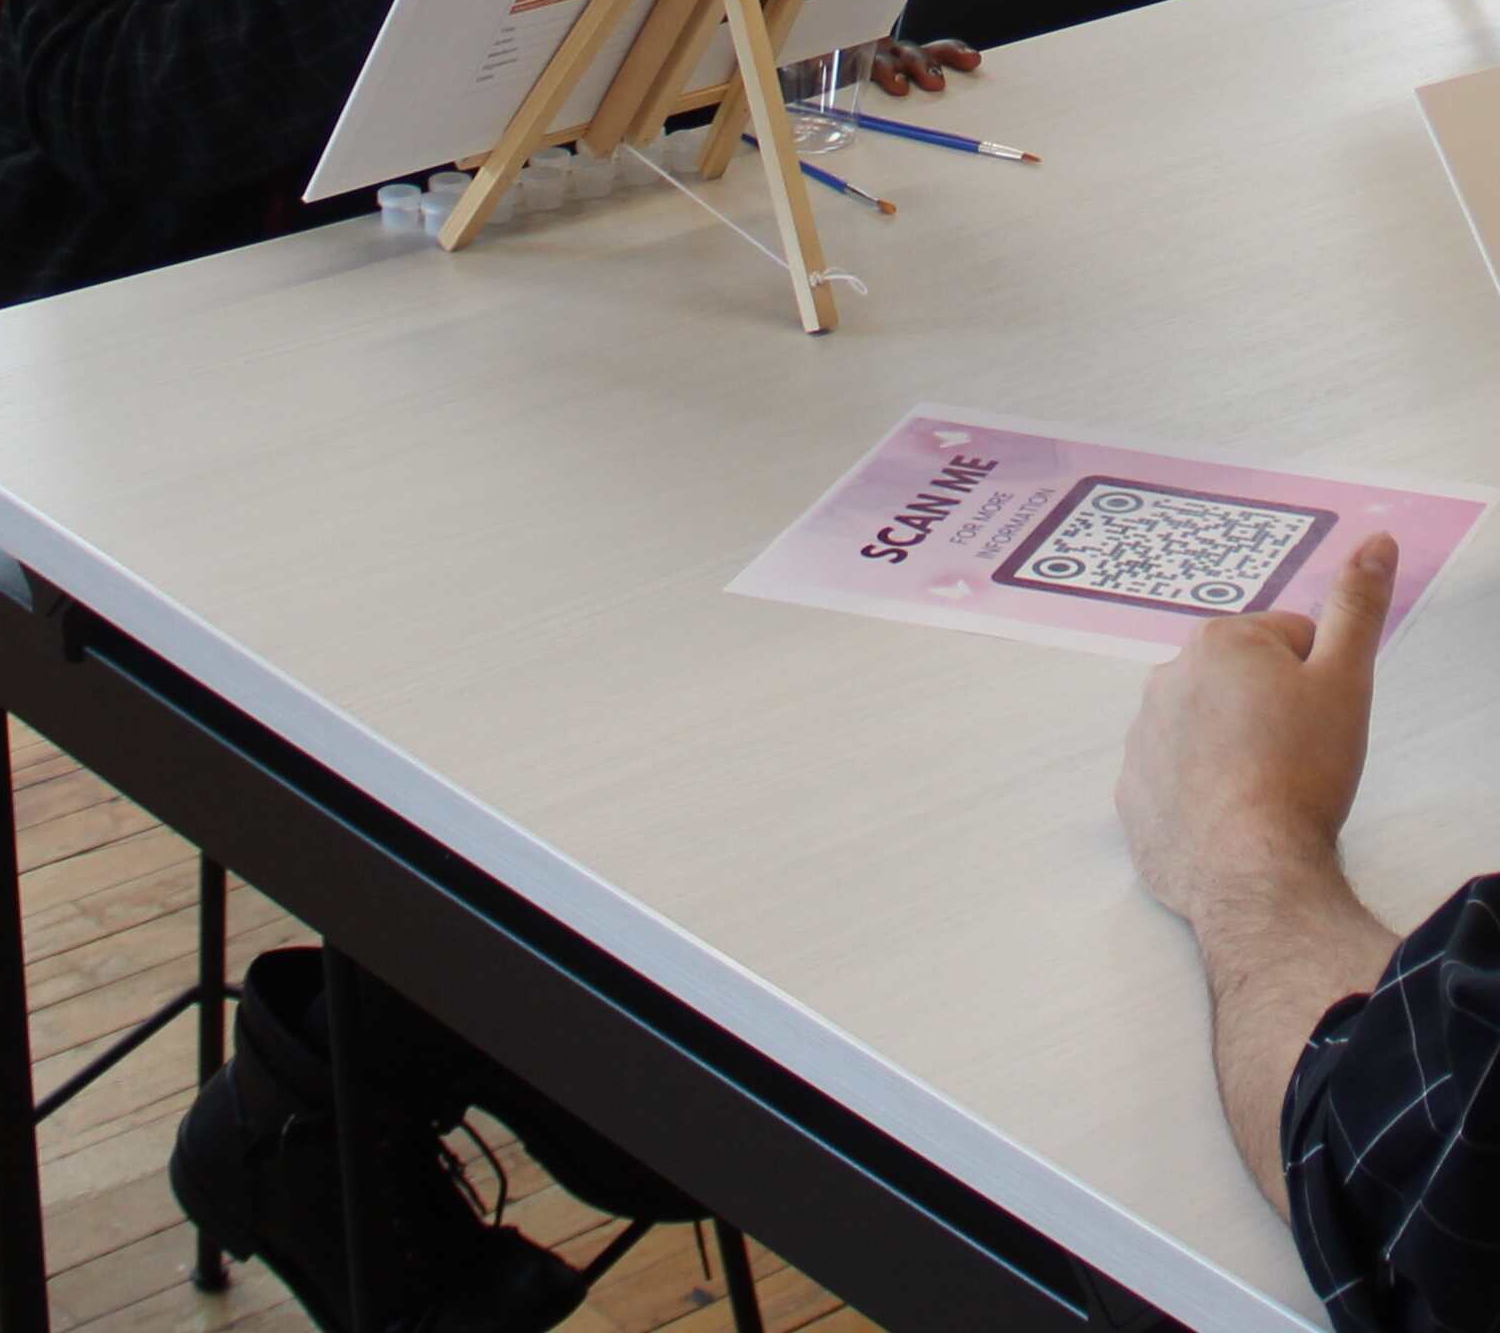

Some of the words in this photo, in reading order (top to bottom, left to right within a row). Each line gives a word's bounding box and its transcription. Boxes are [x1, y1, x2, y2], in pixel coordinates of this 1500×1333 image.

[860, 493, 961, 564] SCAN
[930, 454, 999, 493] ME
[950, 522, 984, 546] FOR
[972, 491, 1015, 525] MORE
[975, 487, 1057, 560] INFORMATION
